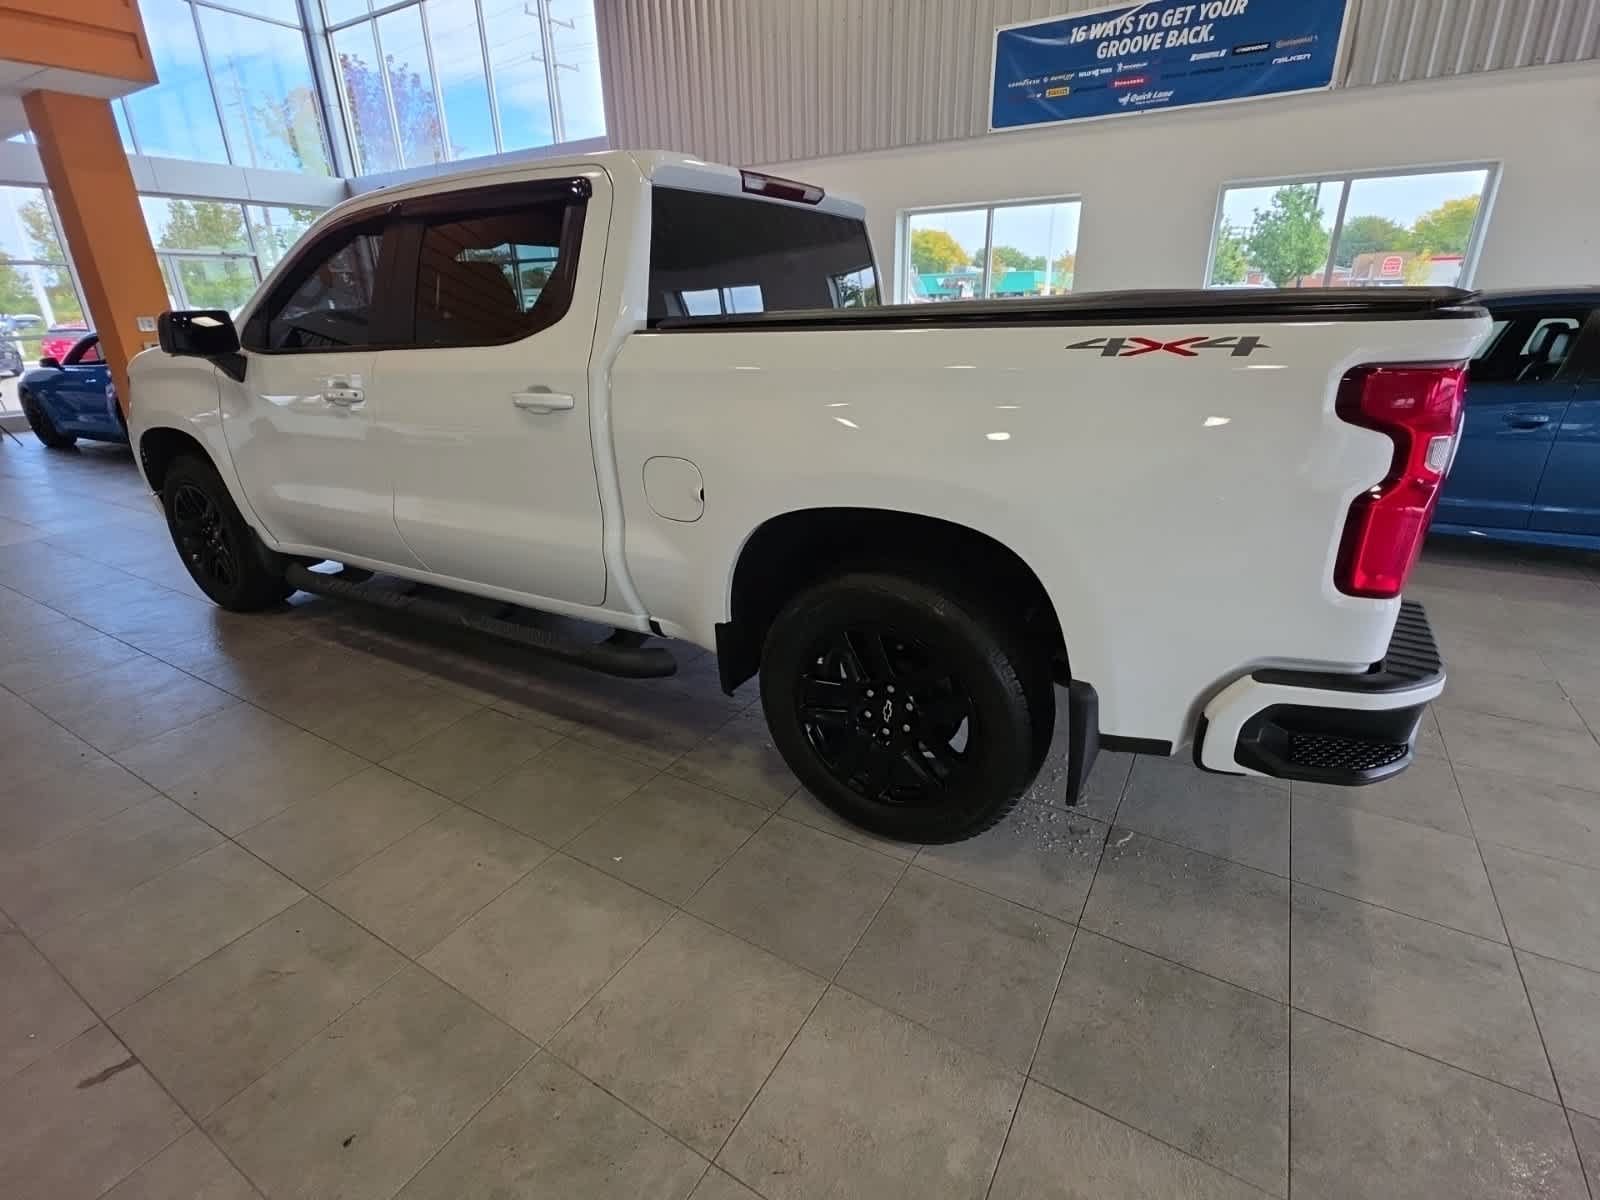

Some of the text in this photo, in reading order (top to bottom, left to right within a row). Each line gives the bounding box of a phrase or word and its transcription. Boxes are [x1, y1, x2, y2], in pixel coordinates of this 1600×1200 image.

[1070, 0, 1249, 44] 16 WAYS TO GET YOUR
[1096, 32, 1162, 60] GROOVE
[1164, 23, 1215, 48] BACK.
[1272, 53, 1312, 65] FALKEN
[1130, 91, 1153, 103] Quick
[1153, 90, 1174, 99] Lane
